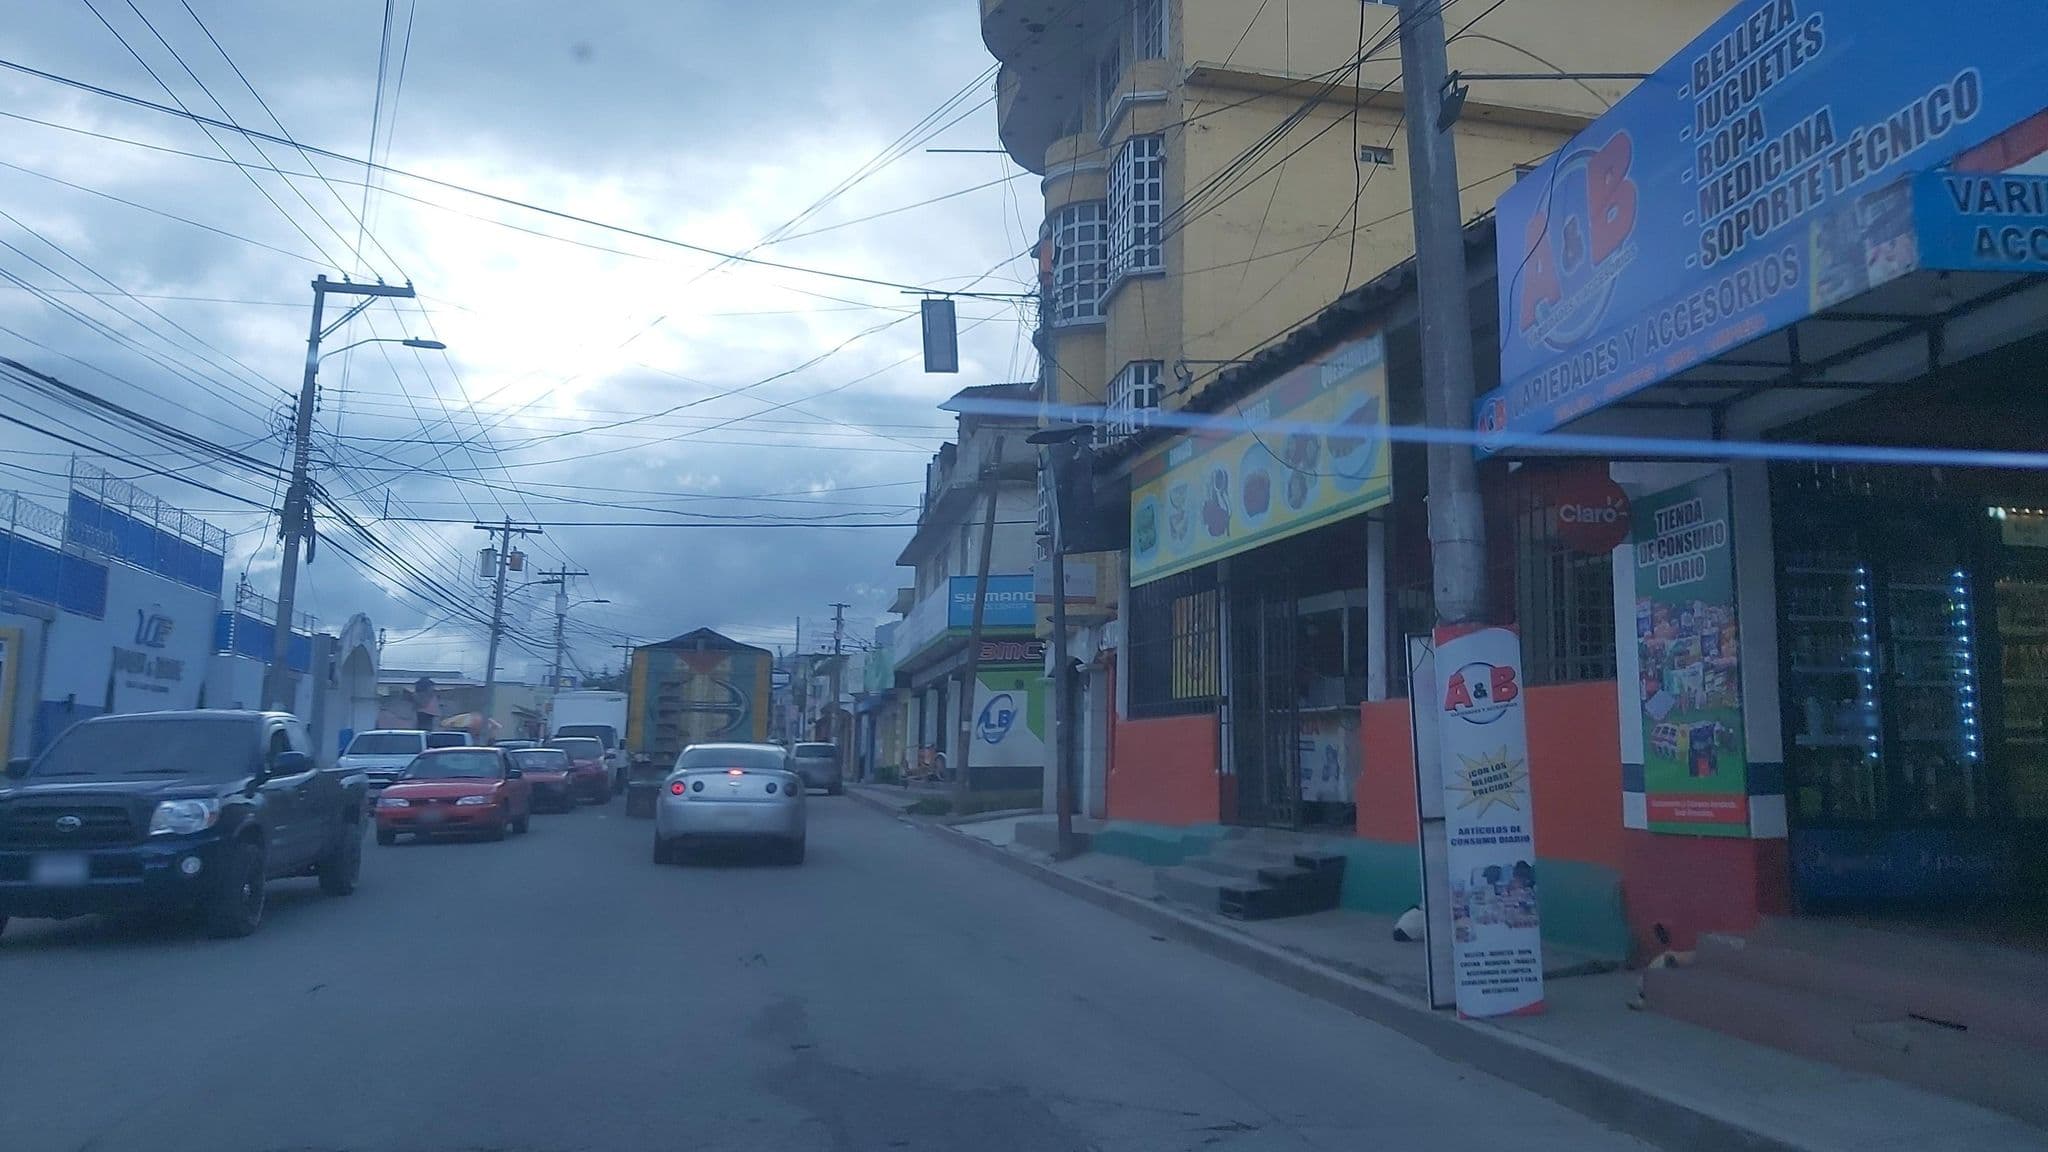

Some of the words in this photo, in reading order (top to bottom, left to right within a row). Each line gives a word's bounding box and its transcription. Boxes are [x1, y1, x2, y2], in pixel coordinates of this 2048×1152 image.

[1693, 0, 1797, 98] BELLEZA
[1694, 12, 1824, 141] JUGUETES
[1697, 104, 1767, 183] ROPA
[1699, 105, 1836, 226] MEDICINA
[1701, 163, 1826, 269] SOPORTE
[1828, 67, 1983, 196] TÉCNICO
[1624, 323, 1640, 365] Y
[1645, 246, 1799, 357] ACCESORIOS
[1559, 502, 1617, 524] Claro
[1637, 541, 1656, 567] DE
[1657, 519, 1727, 561] CONSUMO
[1655, 498, 1704, 535] TIENDA
[1658, 554, 1706, 588] DIARIO
[1444, 672, 1474, 711] A
[1473, 682, 1488, 700] &
[1489, 666, 1519, 704] B
[1450, 837, 1497, 847] CONSUMO
